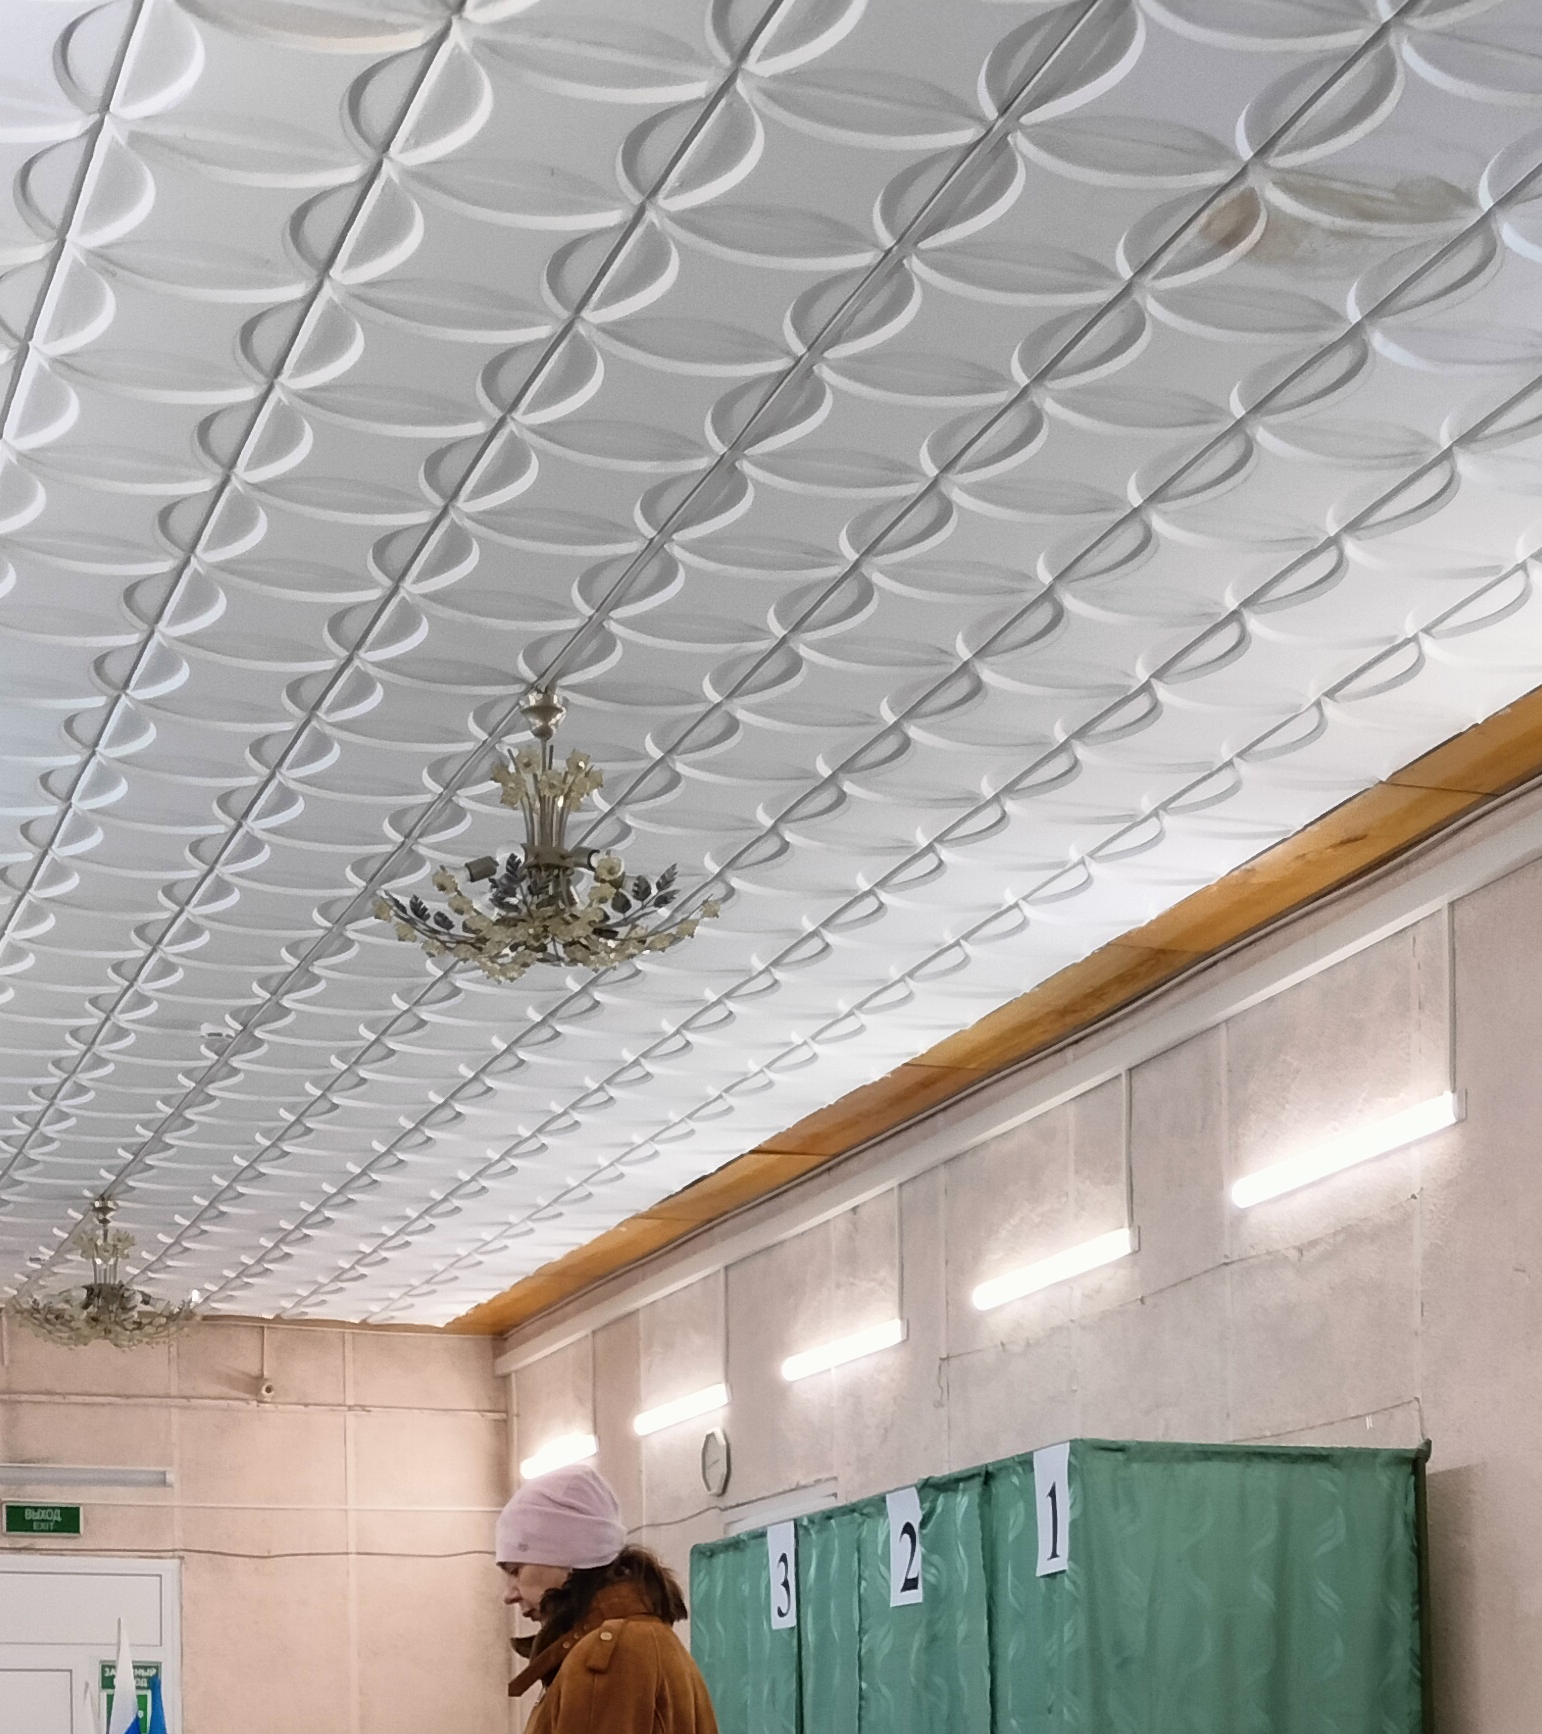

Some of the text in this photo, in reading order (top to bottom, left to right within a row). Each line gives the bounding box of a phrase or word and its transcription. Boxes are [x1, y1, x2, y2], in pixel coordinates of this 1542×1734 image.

[24, 1508, 62, 1522] ВЫХОД
[33, 1521, 55, 1529] EXIT
[1045, 1482, 1061, 1561] 1
[777, 1552, 791, 1618] 3
[899, 1521, 919, 1594] 2
